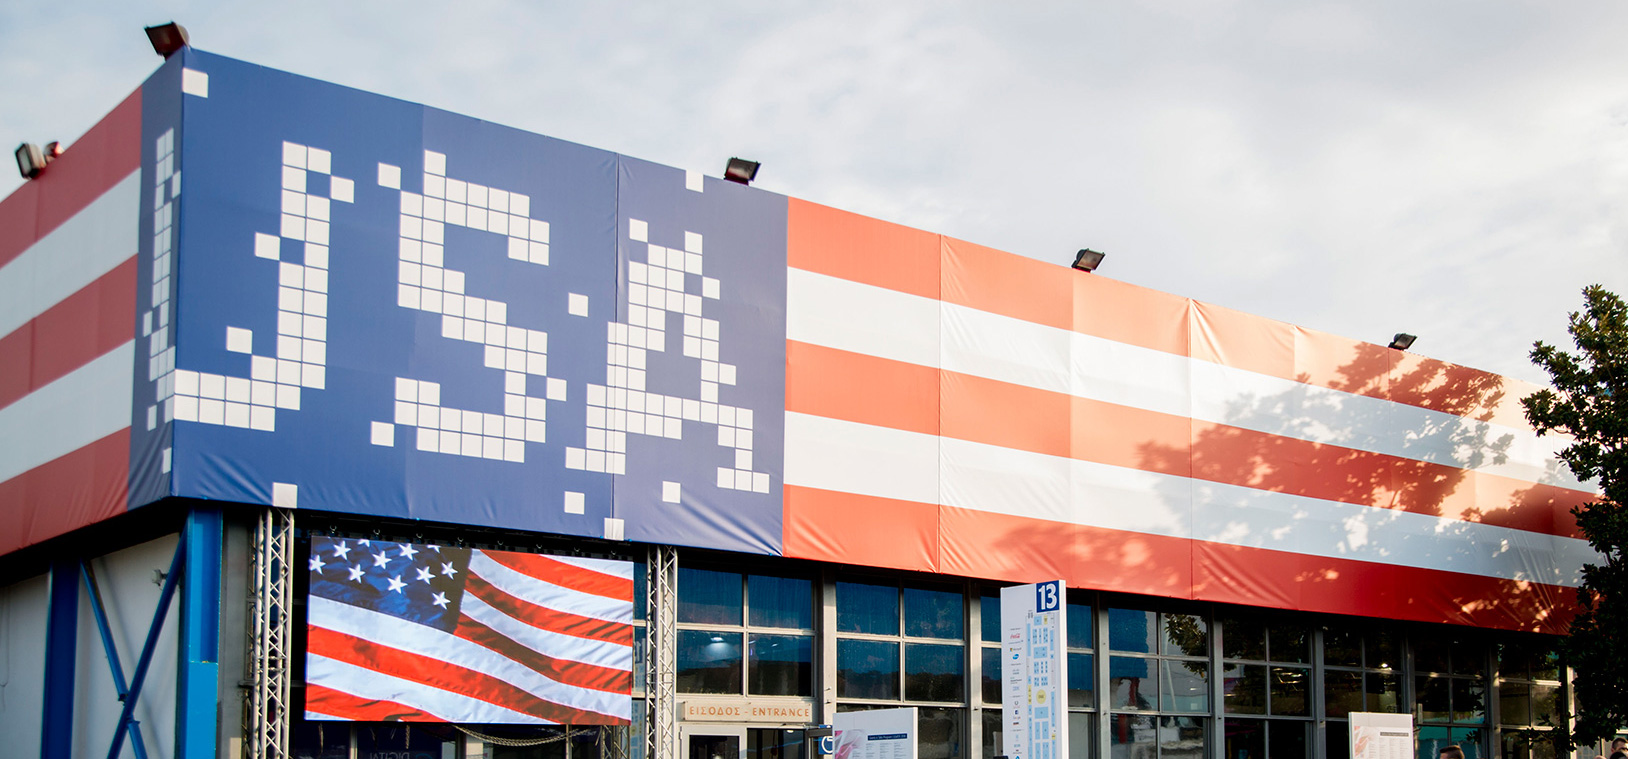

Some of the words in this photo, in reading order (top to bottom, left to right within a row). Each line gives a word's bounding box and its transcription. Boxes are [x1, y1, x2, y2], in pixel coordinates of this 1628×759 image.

[1038, 583, 1058, 610] 13
[689, 706, 741, 716] ΕΙΣΟΔΟΣ
[752, 707, 810, 717] ENTRANCE
